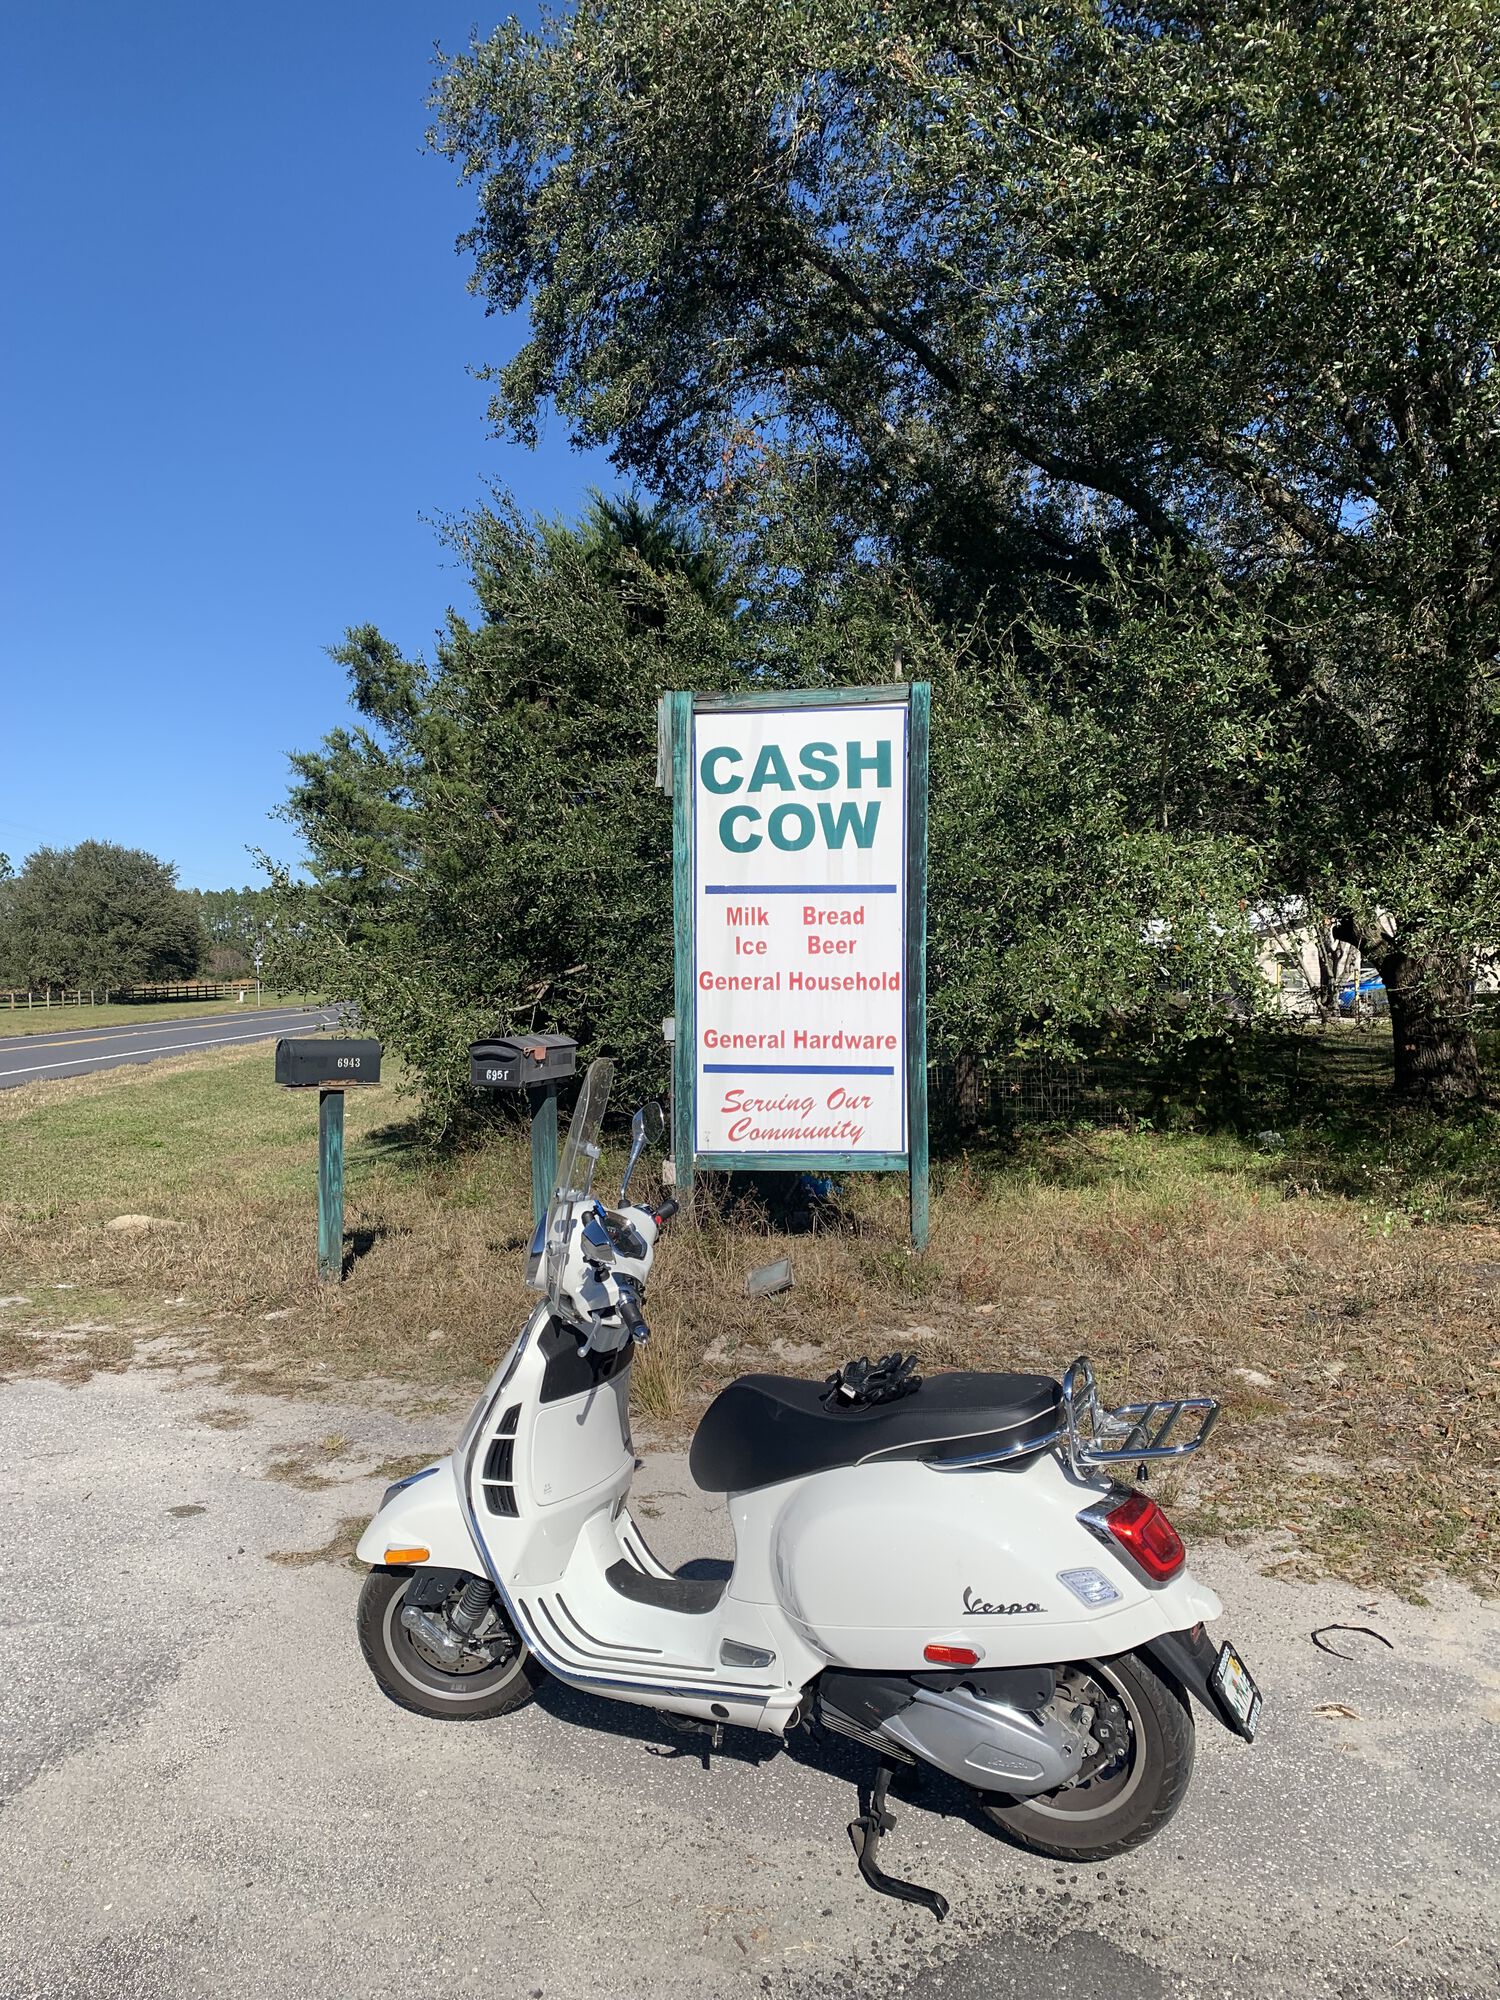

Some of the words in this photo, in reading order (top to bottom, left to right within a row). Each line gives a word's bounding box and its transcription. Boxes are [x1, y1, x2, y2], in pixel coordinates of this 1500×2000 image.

[700, 740, 891, 795] CASH
[718, 801, 881, 853] COW
[726, 906, 769, 926] Milk
[802, 905, 865, 926] Bread
[735, 936, 767, 955] Ice
[807, 934, 857, 955] Beer
[699, 971, 781, 991] General
[788, 970, 901, 991] Household
[703, 1029, 786, 1050] General
[793, 1029, 897, 1050] Hardware
[337, 1058, 361, 1068] 6943
[721, 1087, 817, 1122] Serving
[826, 1087, 873, 1110] Our
[727, 1117, 865, 1145] Community
[962, 1586, 1048, 1615] Vespa
